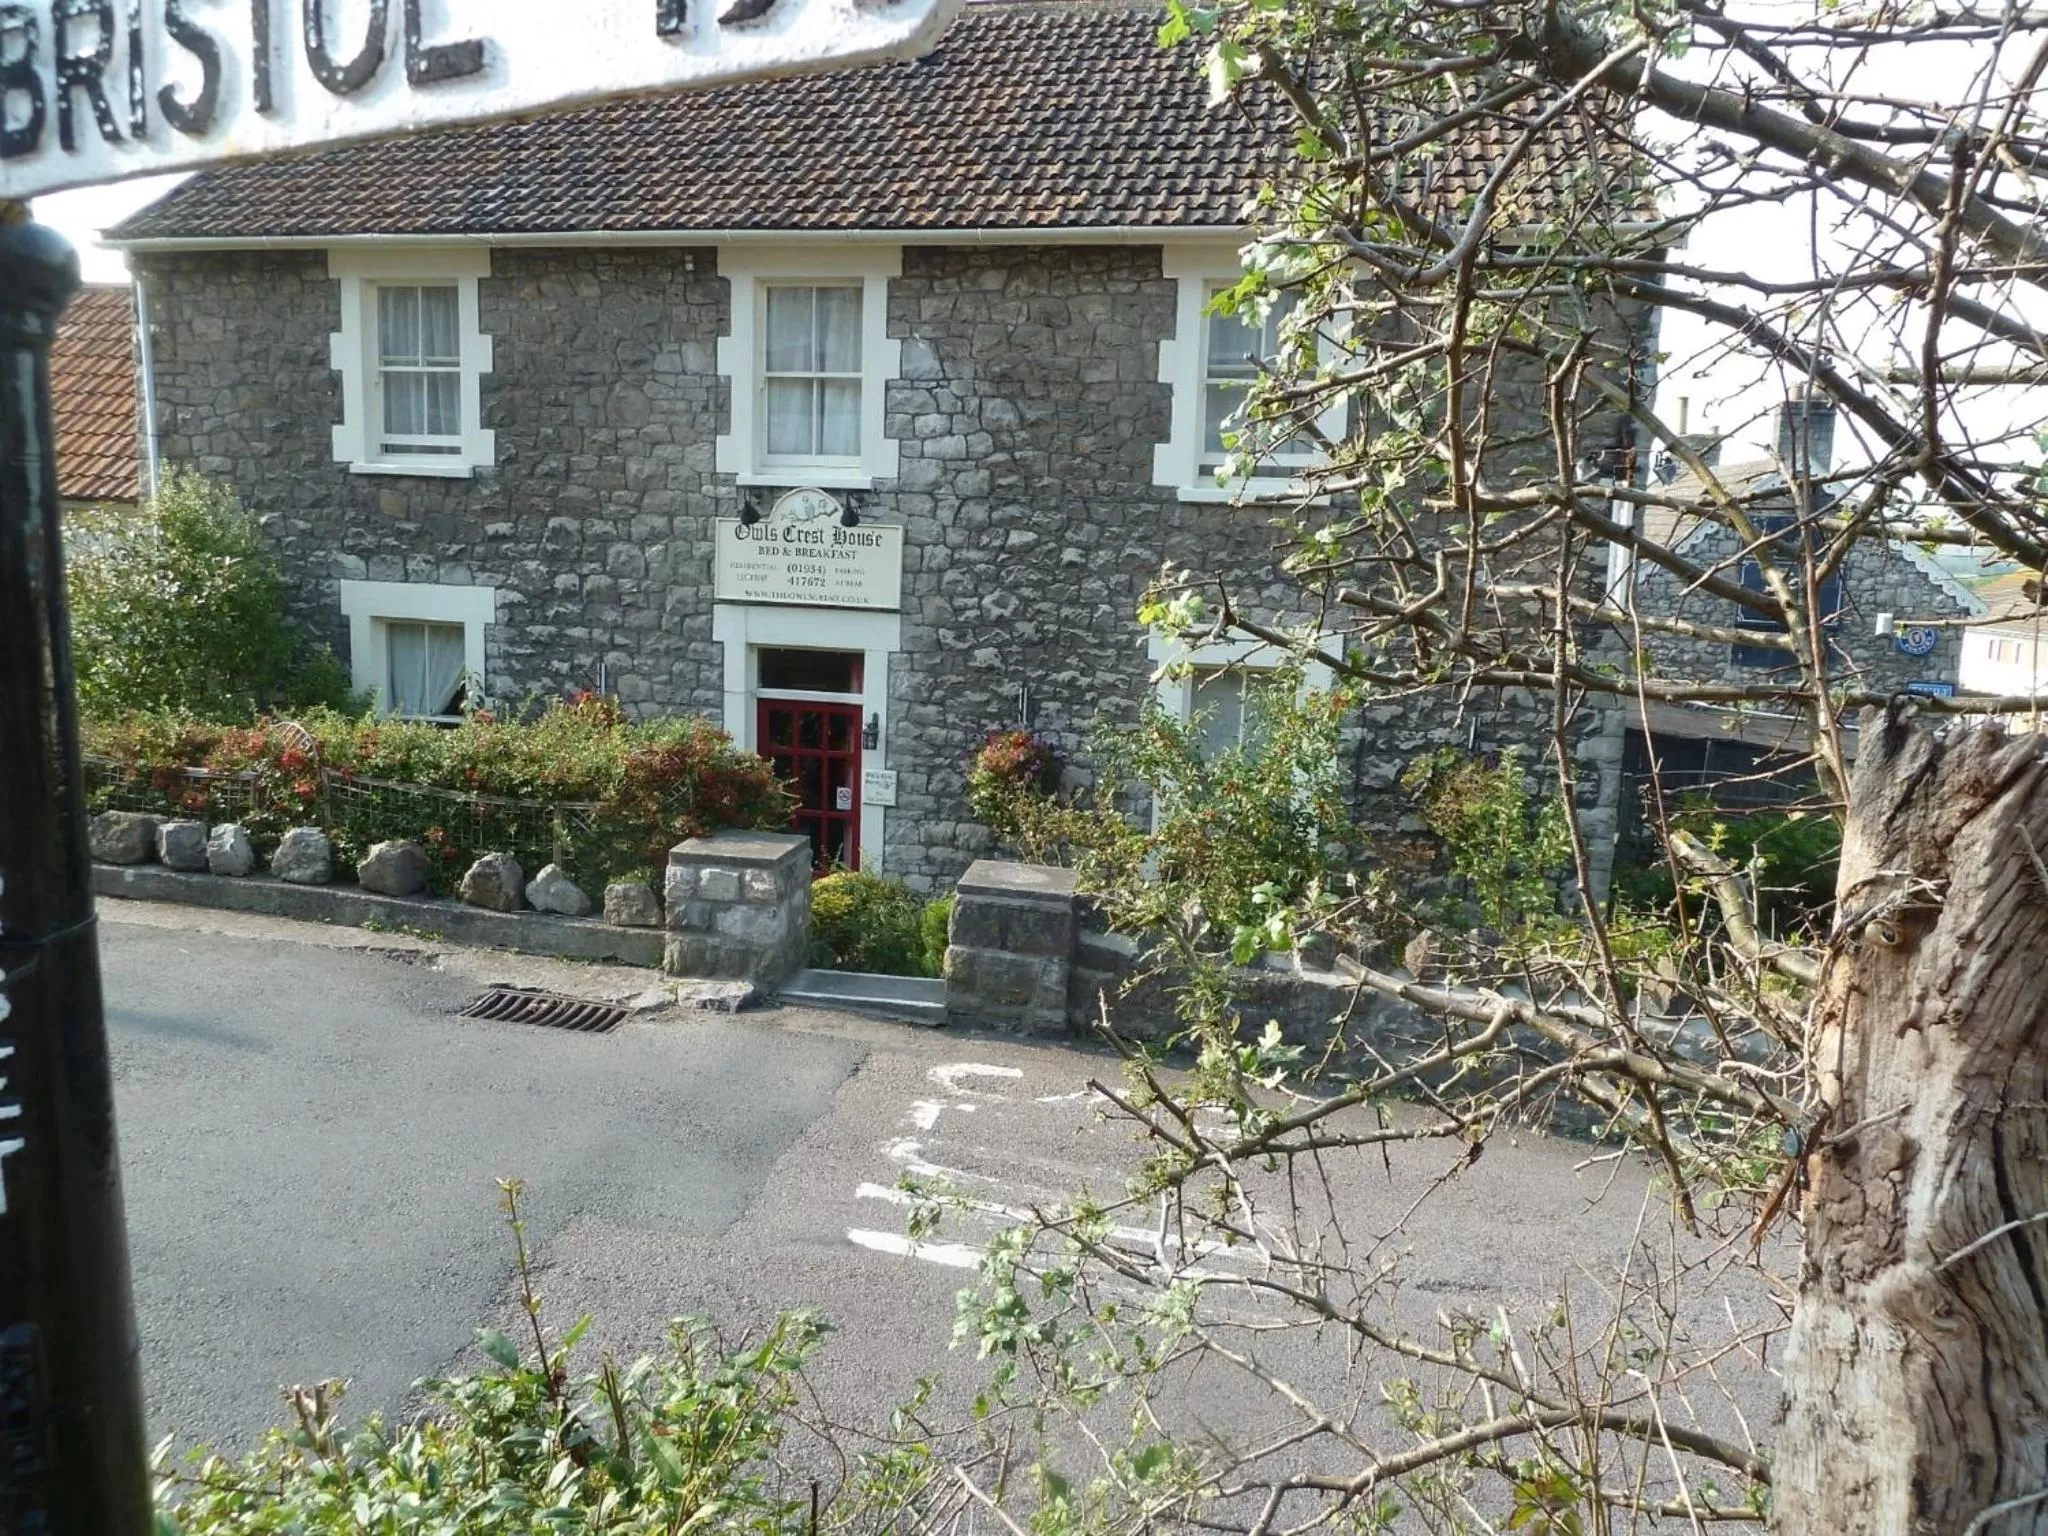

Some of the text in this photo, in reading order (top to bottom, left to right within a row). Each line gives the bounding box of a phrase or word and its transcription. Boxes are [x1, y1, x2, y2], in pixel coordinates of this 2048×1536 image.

[735, 523, 883, 549] Owls Crest House
[758, 546, 858, 561] BED & BREAKFAST
[787, 563, 827, 575] (01934)
